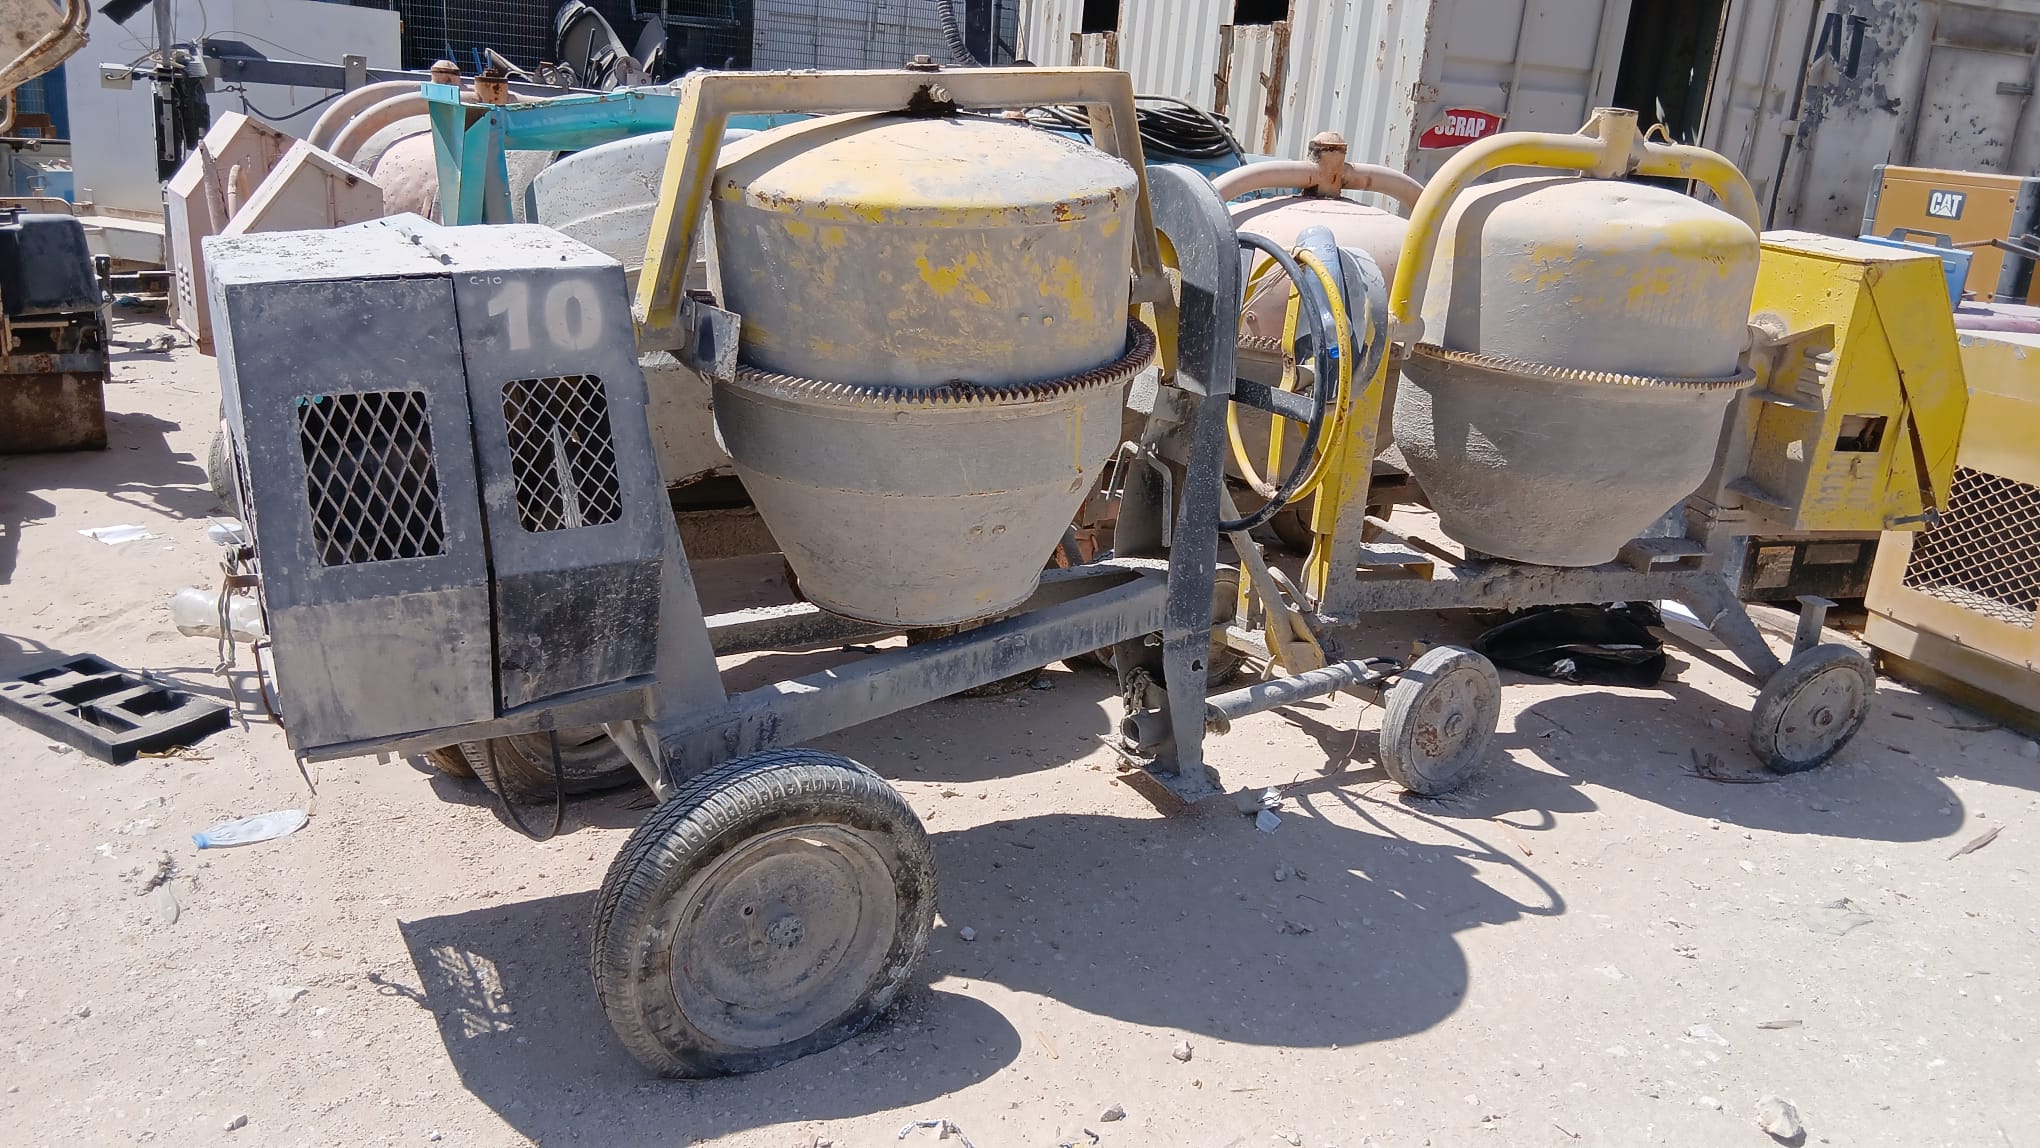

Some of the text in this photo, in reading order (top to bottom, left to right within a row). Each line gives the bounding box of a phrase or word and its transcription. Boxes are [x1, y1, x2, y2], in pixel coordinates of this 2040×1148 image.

[1929, 192, 1962, 217] CAT
[469, 276, 503, 285] C-10
[487, 279, 602, 351] 10
